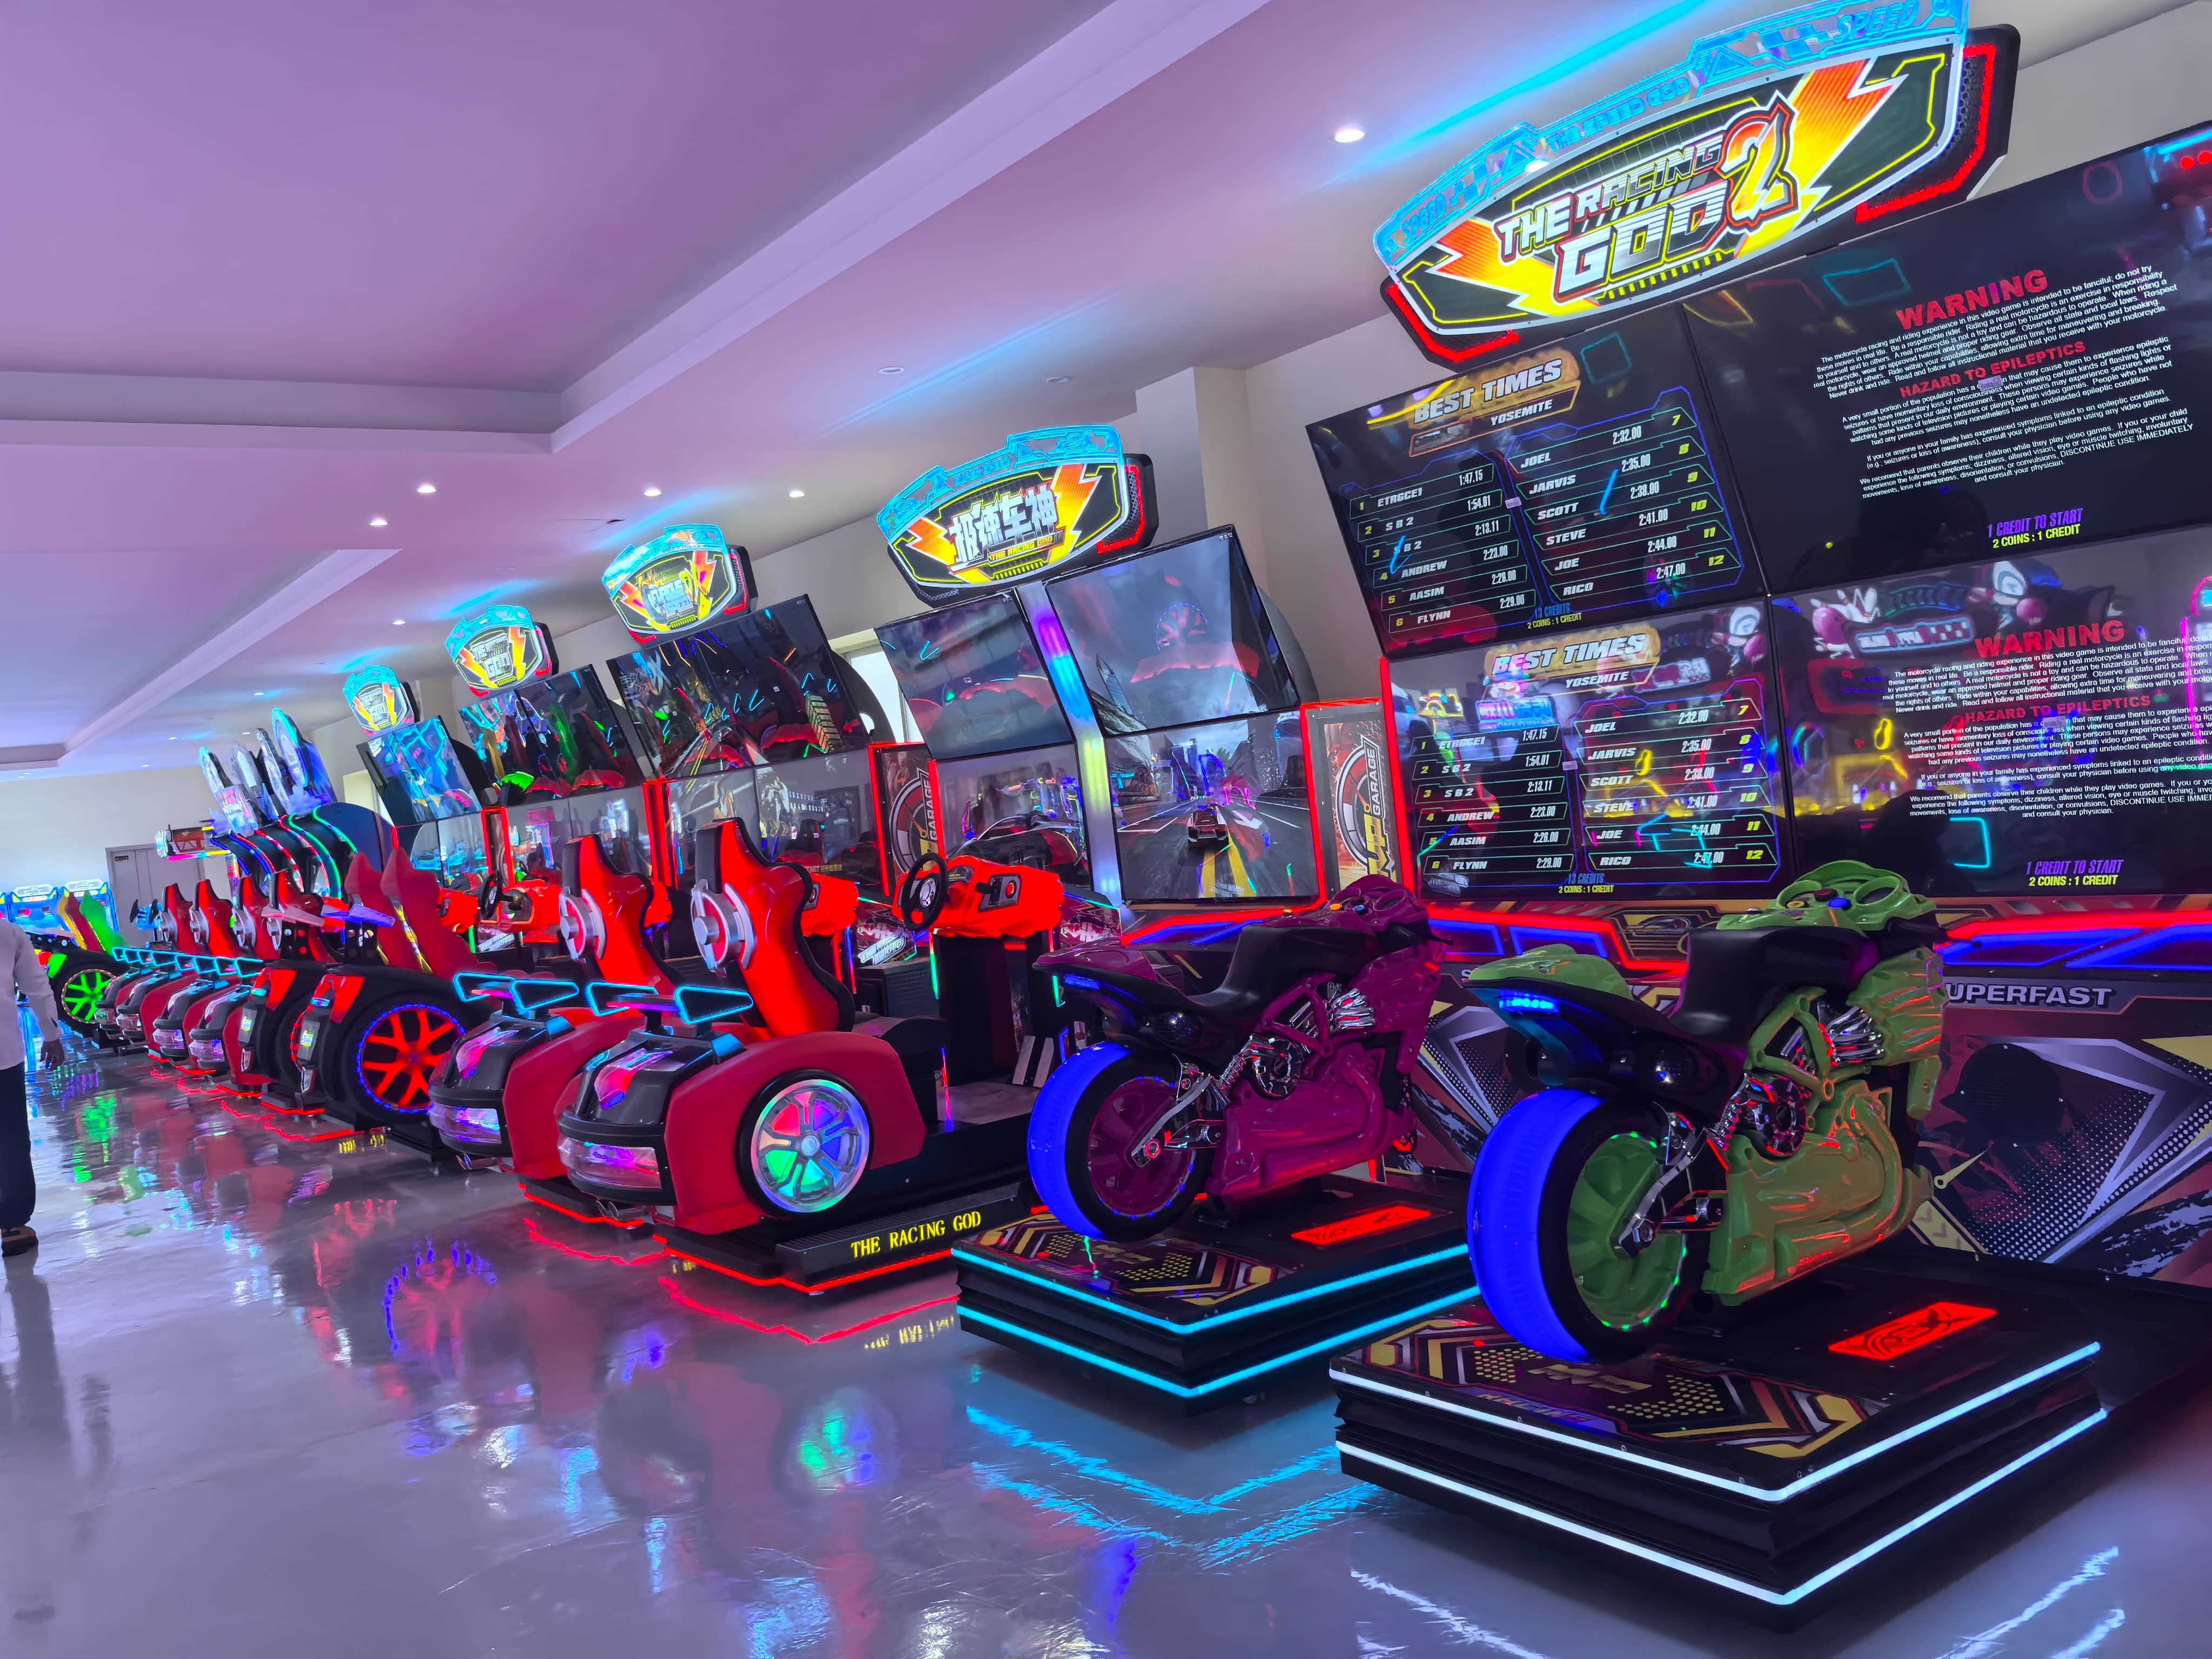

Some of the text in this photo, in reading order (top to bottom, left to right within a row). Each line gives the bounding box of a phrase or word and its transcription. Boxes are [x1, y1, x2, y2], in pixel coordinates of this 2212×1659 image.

[1832, 0, 1919, 43] SPEED
[1545, 77, 1690, 152] THE SPEED GOD
[1495, 133, 1724, 258] THE RACING
[1557, 104, 1794, 298] GOD 2
[1402, 194, 1447, 244] SPEED
[1896, 269, 2048, 330] WARNING
[1900, 341, 2086, 397] HAZARD TO EPILEPTICS
[1414, 359, 1562, 423] BEST TIMES
[1491, 399, 1553, 426] YOSEMITE
[1872, 453, 1884, 461] you
[1893, 446, 1916, 456] anyone
[1924, 441, 1938, 450] your
[1940, 436, 1959, 447] family
[1961, 433, 1973, 441] has
[1974, 422, 2016, 439] experienced
[2017, 414, 2052, 428] symptoms
[2054, 409, 2075, 420] linked
[2097, 397, 2128, 410] epileptic
[2129, 389, 2164, 402] condition
[1521, 415, 1681, 469] JOEL 2:32.00 7
[1960, 464, 2006, 478] disorientation,
[2016, 454, 2059, 468] convulsions,
[2060, 441, 2116, 457] DISCONTINUE
[2117, 435, 2136, 446] USE
[2137, 423, 2193, 441] IMMEDIATELY
[1529, 443, 1689, 495] JARVIS 2:35.00 8
[1988, 469, 2013, 480] consult
[2014, 466, 2029, 476] your
[1359, 502, 1364, 510] 1
[1459, 469, 1483, 486] 1:47.15
[1537, 471, 1698, 521] SCOTT 2:38.00 9
[1365, 526, 1373, 535] 2
[1386, 522, 1393, 531] S
[1406, 517, 1414, 526] 2
[1467, 495, 1491, 512] 1:54.01
[1546, 500, 1707, 546] STEVE 2:41.00 10
[1987, 508, 2083, 538] 1 CREDIT TO START
[990, 536, 1053, 561] THE RACING GOD
[1373, 549, 1380, 558] 3
[1414, 541, 1421, 550] 2
[1475, 520, 1499, 537] 2:13.11
[1555, 527, 1716, 571] JOE 2:44.00 11
[1993, 539, 2000, 548] 2
[2001, 533, 2030, 547] COINS
[2037, 531, 2042, 541] 1
[2046, 523, 2080, 539] CREDIT
[1380, 544, 1508, 581] 4 ANDREW 2:23.00
[1563, 555, 1724, 596] RICO 2:47.00 12
[1388, 596, 1395, 604] 5
[1409, 586, 1445, 601] AASIM
[1396, 618, 1404, 626] 6
[1417, 610, 1451, 624] FLYNN
[1533, 617, 1550, 628] COINS
[1555, 616, 1559, 624] 1
[1561, 612, 1582, 623] CREDIT
[1545, 603, 1570, 616] CREDITS
[1974, 620, 2125, 658] WARNING
[1492, 634, 1647, 675] BEST TIMES
[1566, 671, 1629, 689] YOSEMITE
[1585, 710, 1709, 733] JOEL 2:32.00
[1965, 696, 2151, 724] HAZARD TO EPILEPTICS
[1522, 728, 1548, 742] 1:47.15
[1525, 754, 1550, 767] 1:54.01
[1588, 739, 1711, 760] JARVIS 2:35.00
[1366, 748, 1381, 816] GARAGE
[1527, 779, 1553, 793] 2:13.11
[1590, 775, 1633, 787] SCOTT
[1447, 805, 1556, 822] ANDREW 2:23.00
[1594, 795, 1717, 813] STEVE 2:41.00
[1449, 837, 1486, 846] AASIM
[1596, 830, 1623, 839] JOE
[1453, 857, 1562, 870] FLYNN 2:29.00
[1600, 857, 1631, 866] RICO
[2026, 859, 2124, 875] 1 CREDIT TO START
[1559, 886, 1563, 894] 2
[1565, 885, 1583, 893] COINS
[1592, 885, 1614, 893] CREDIT
[1568, 873, 1604, 884] 13 CREDITS
[2028, 877, 2036, 886] 2
[2038, 876, 2067, 886] COINS
[2074, 876, 2079, 885] 1
[2082, 875, 2118, 885] CREDIT
[1945, 983, 2112, 1006] UPERFAST
[851, 1211, 982, 1259] THE RACING GOD
